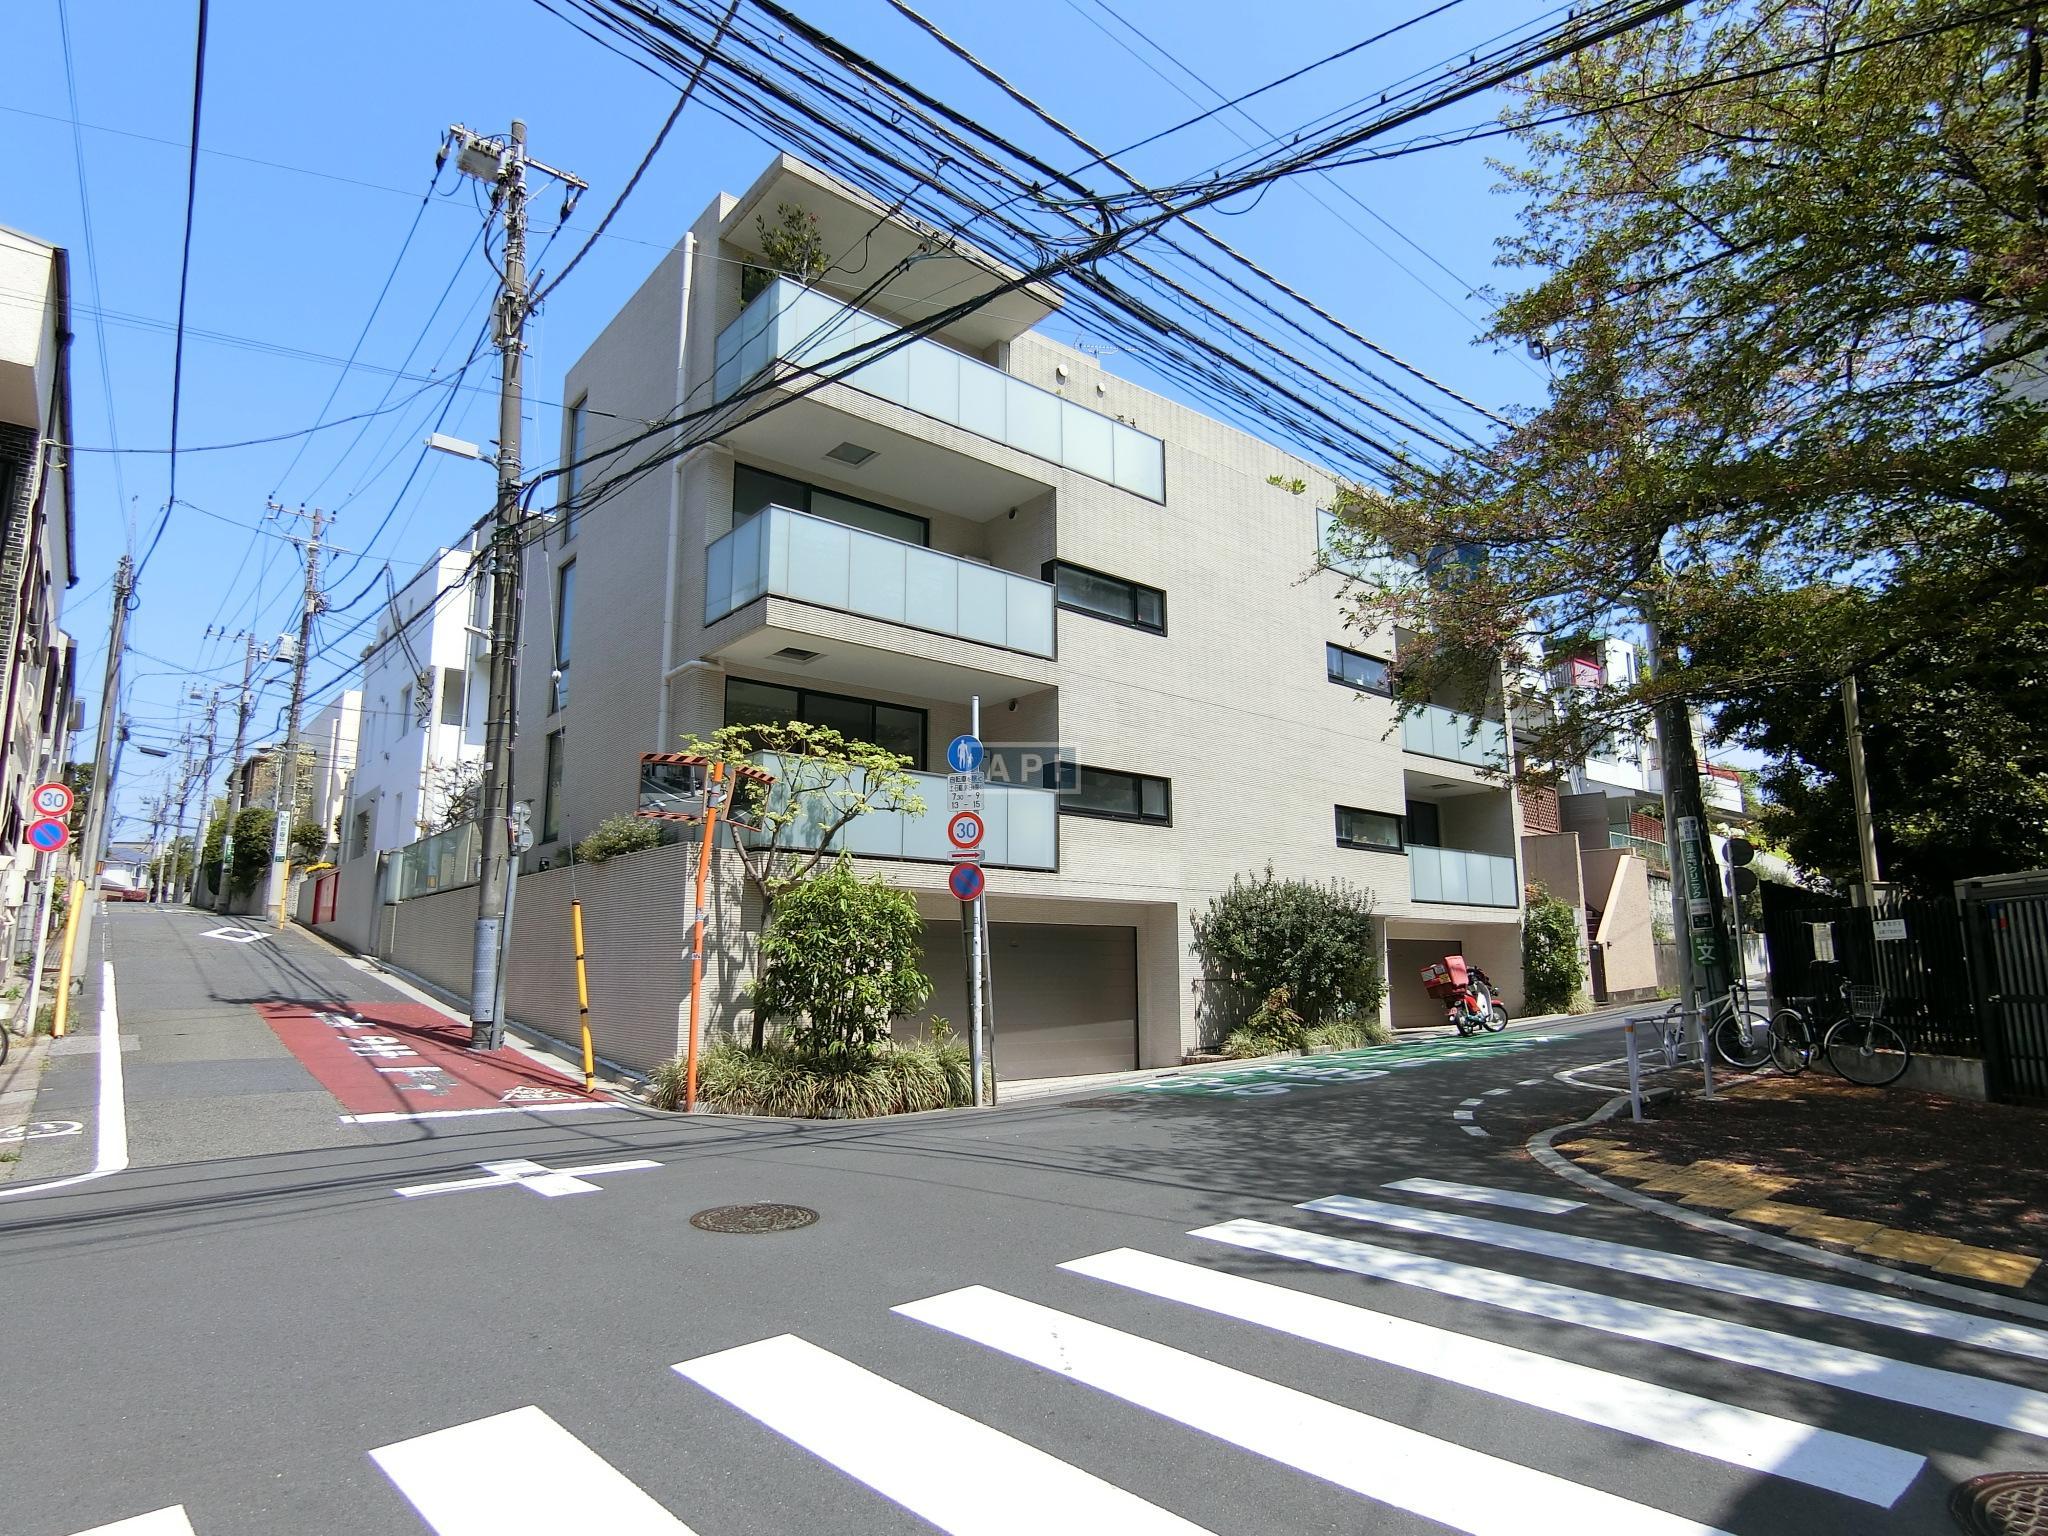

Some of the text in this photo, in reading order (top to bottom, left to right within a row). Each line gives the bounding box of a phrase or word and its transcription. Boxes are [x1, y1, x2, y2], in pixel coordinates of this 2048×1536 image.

[42, 792, 65, 807] 30
[956, 822, 976, 838] 30
[1696, 944, 1716, 960] 文
